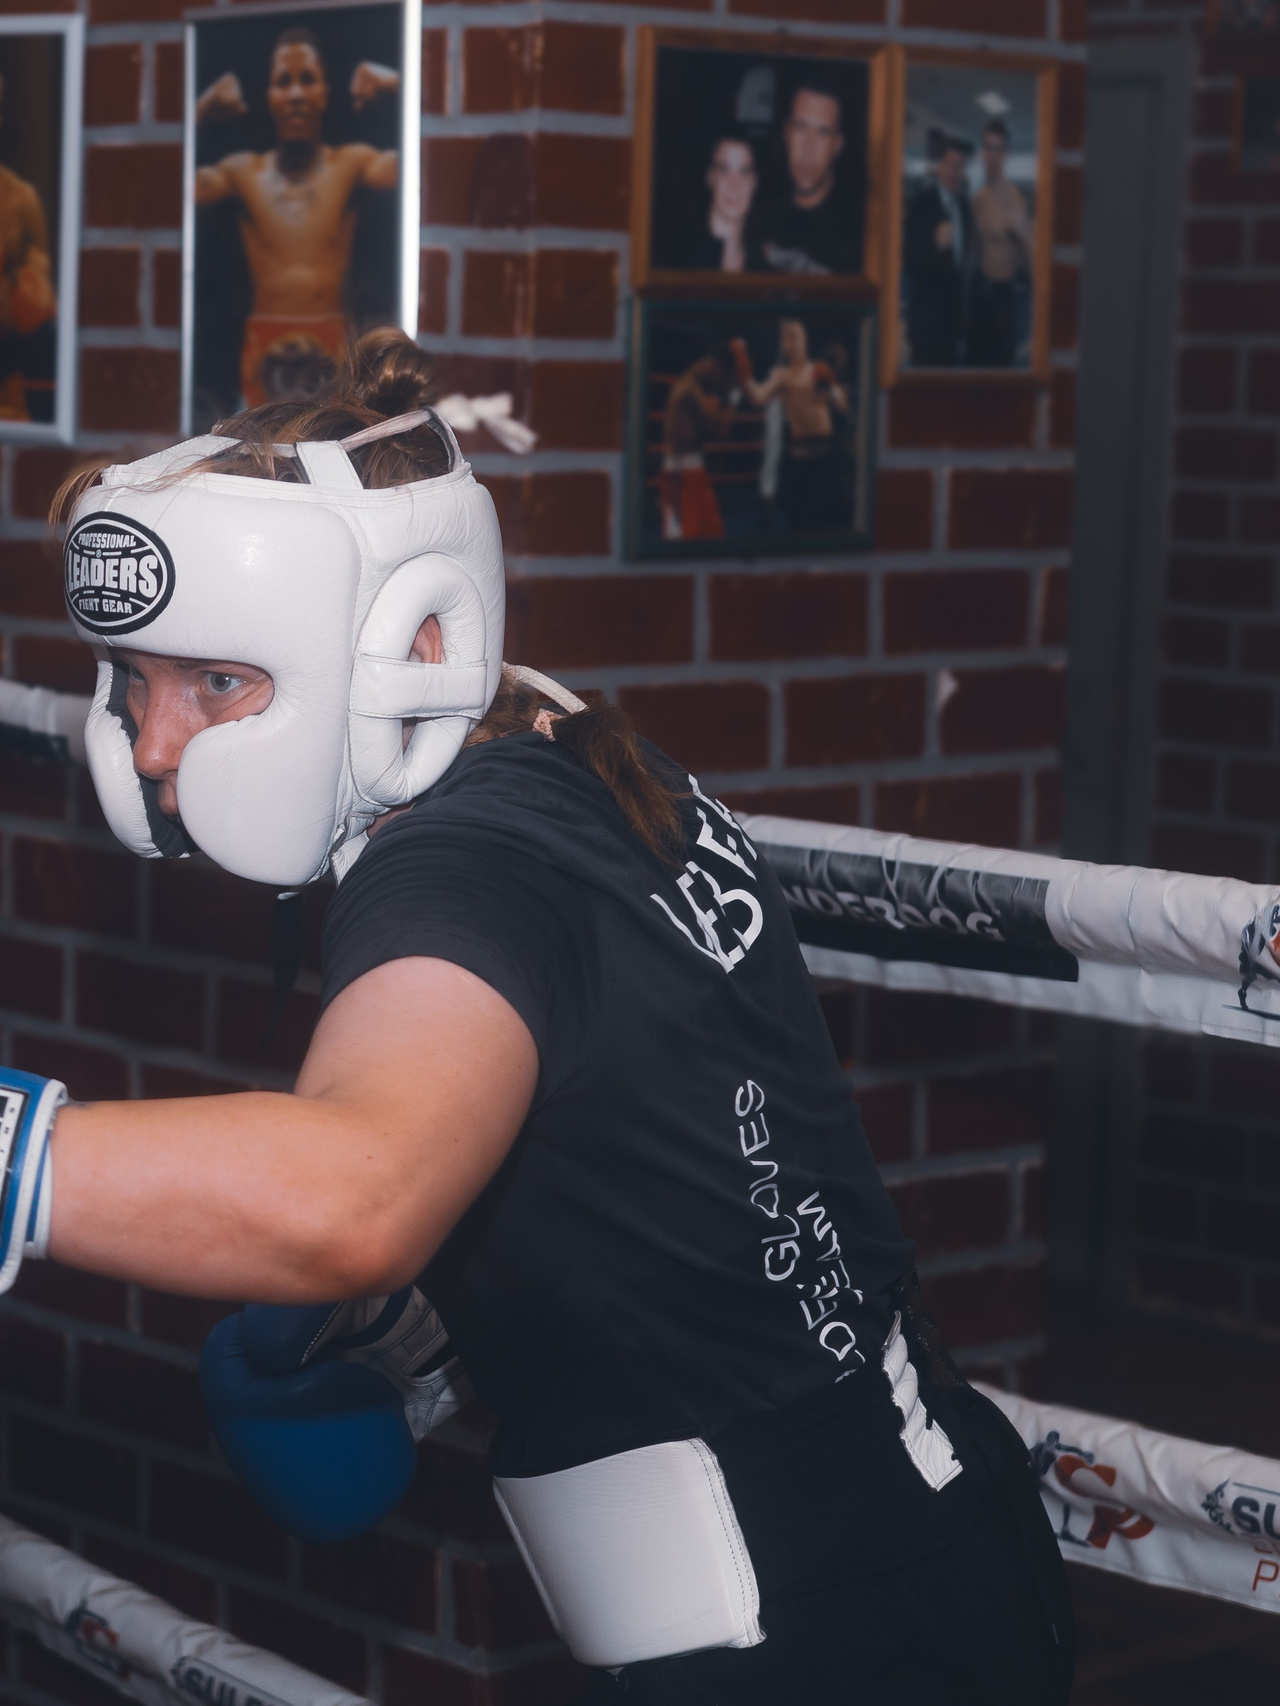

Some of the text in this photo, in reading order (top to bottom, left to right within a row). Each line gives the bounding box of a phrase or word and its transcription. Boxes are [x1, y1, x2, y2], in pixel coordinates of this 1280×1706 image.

[78, 532, 137, 549] PROFESSIONAL
[67, 549, 158, 598] LEADERS
[78, 597, 133, 614] FIGHT GEAR
[734, 1079, 801, 1282] GLOVES
